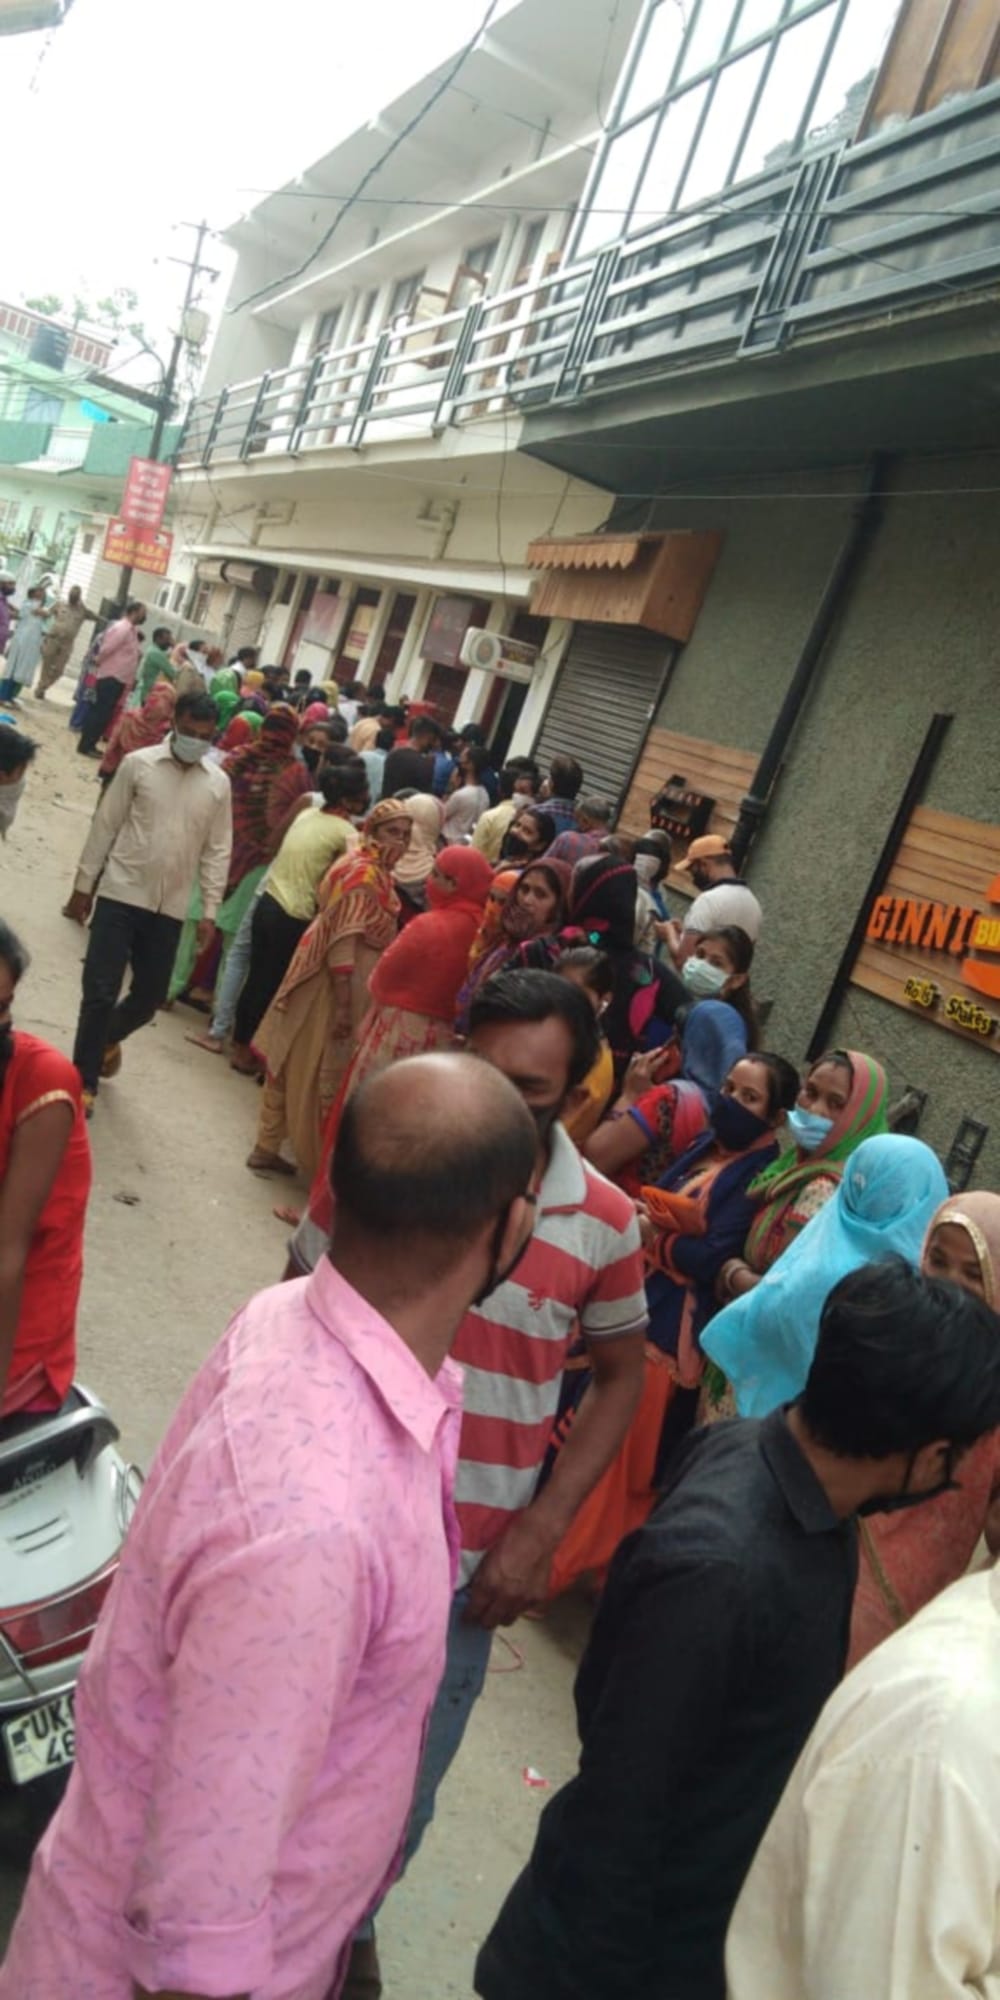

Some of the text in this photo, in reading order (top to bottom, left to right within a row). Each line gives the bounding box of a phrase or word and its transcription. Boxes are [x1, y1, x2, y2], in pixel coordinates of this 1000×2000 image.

[867, 896, 974, 951] GINNI
[904, 976, 992, 1033] Rolls Shakes
